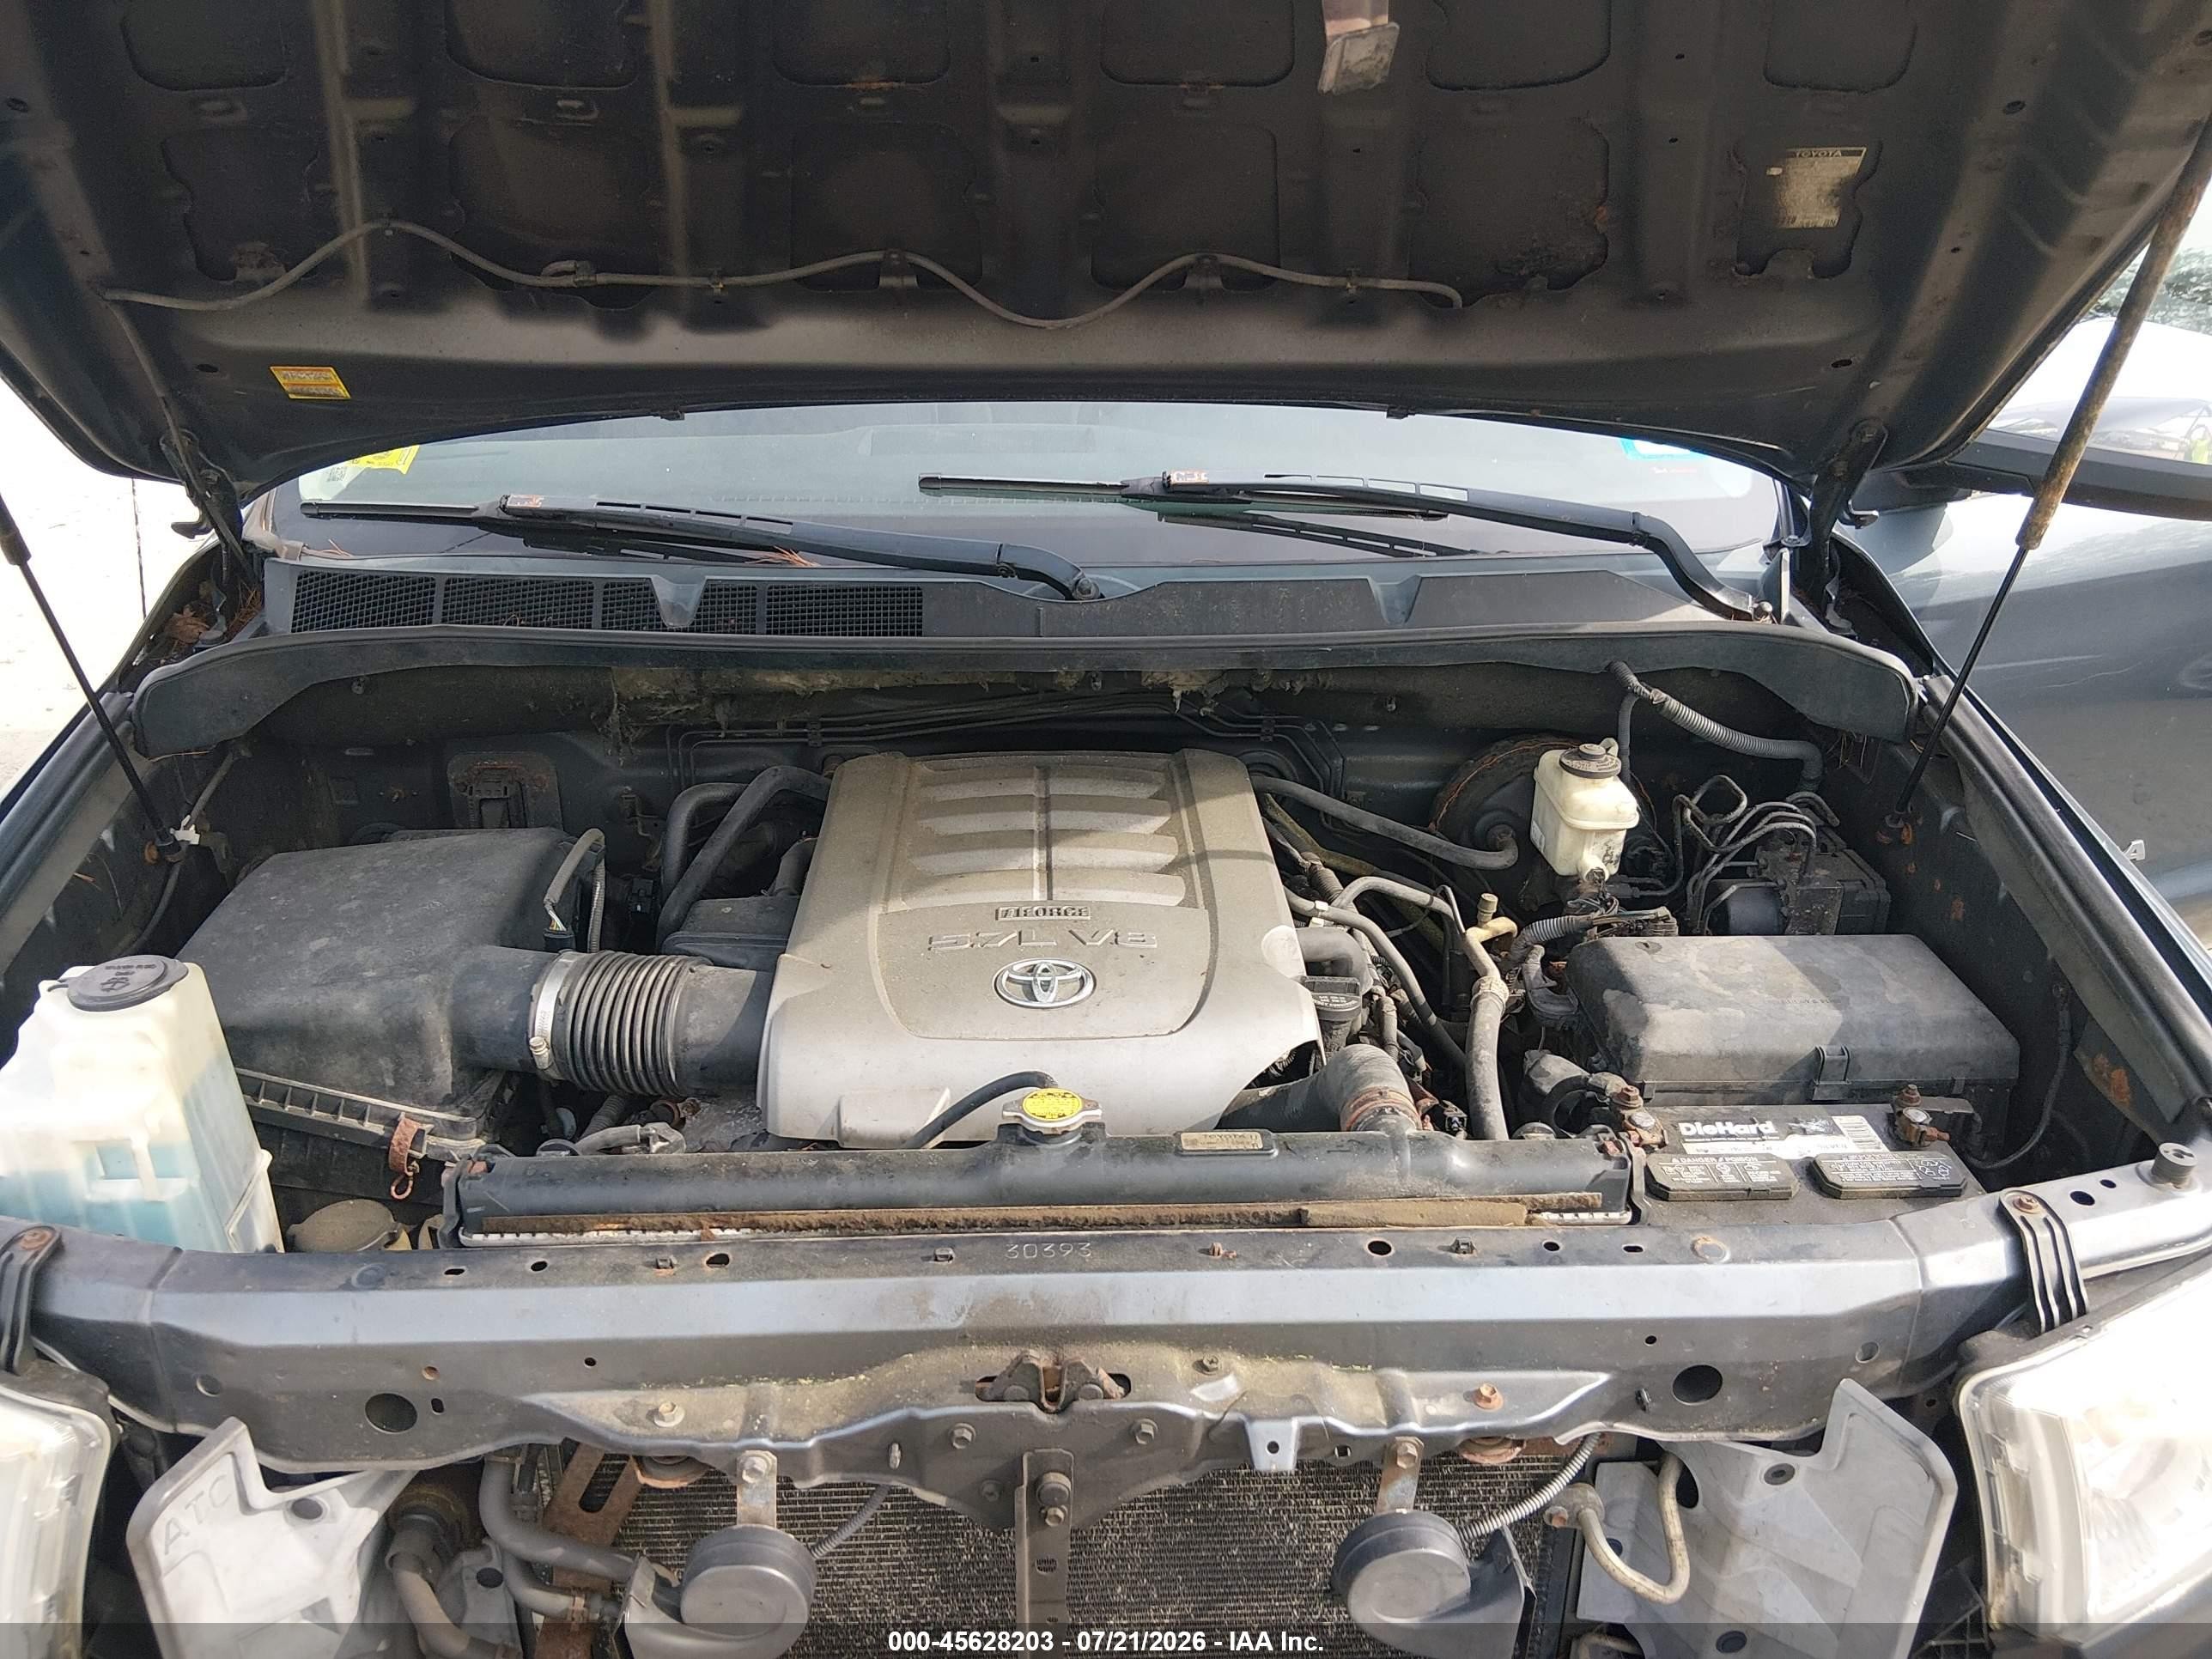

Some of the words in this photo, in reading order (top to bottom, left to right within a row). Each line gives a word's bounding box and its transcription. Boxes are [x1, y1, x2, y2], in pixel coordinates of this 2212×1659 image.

[1067, 928, 1158, 949] V8
[1678, 1121, 1778, 1137] DieHard
[1006, 1242, 1092, 1259] 30393
